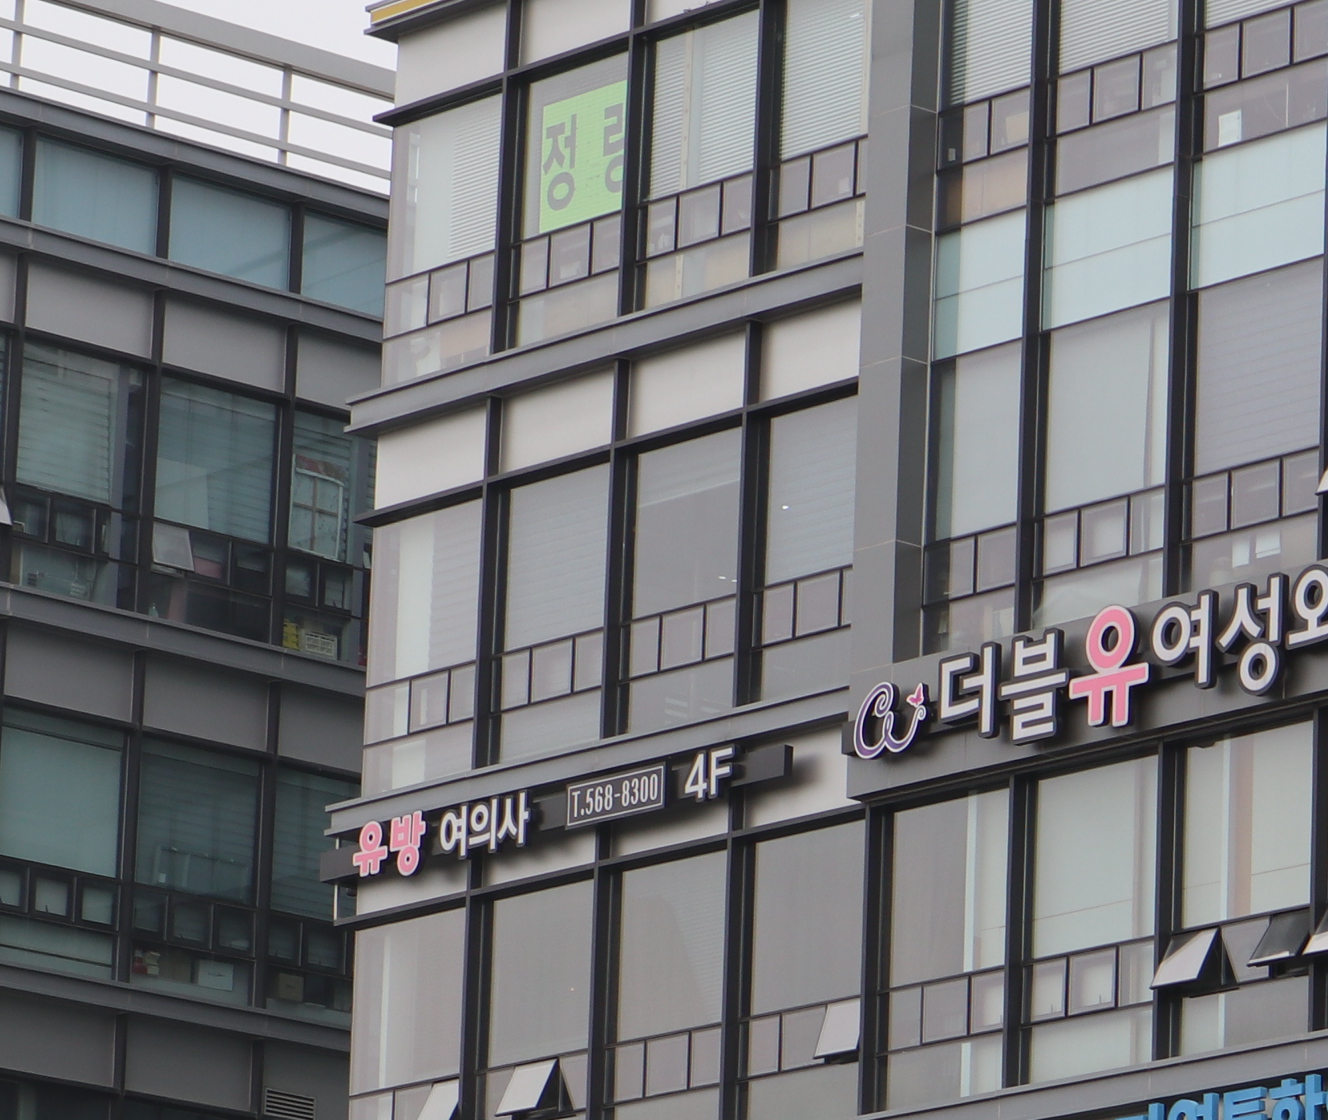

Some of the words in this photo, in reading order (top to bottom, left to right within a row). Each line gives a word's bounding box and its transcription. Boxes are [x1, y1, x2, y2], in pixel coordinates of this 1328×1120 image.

[353, 820, 427, 878] 유방
[438, 792, 531, 858] 여의사
[571, 770, 659, 819] T.568-8300
[683, 748, 735, 801] 4F
